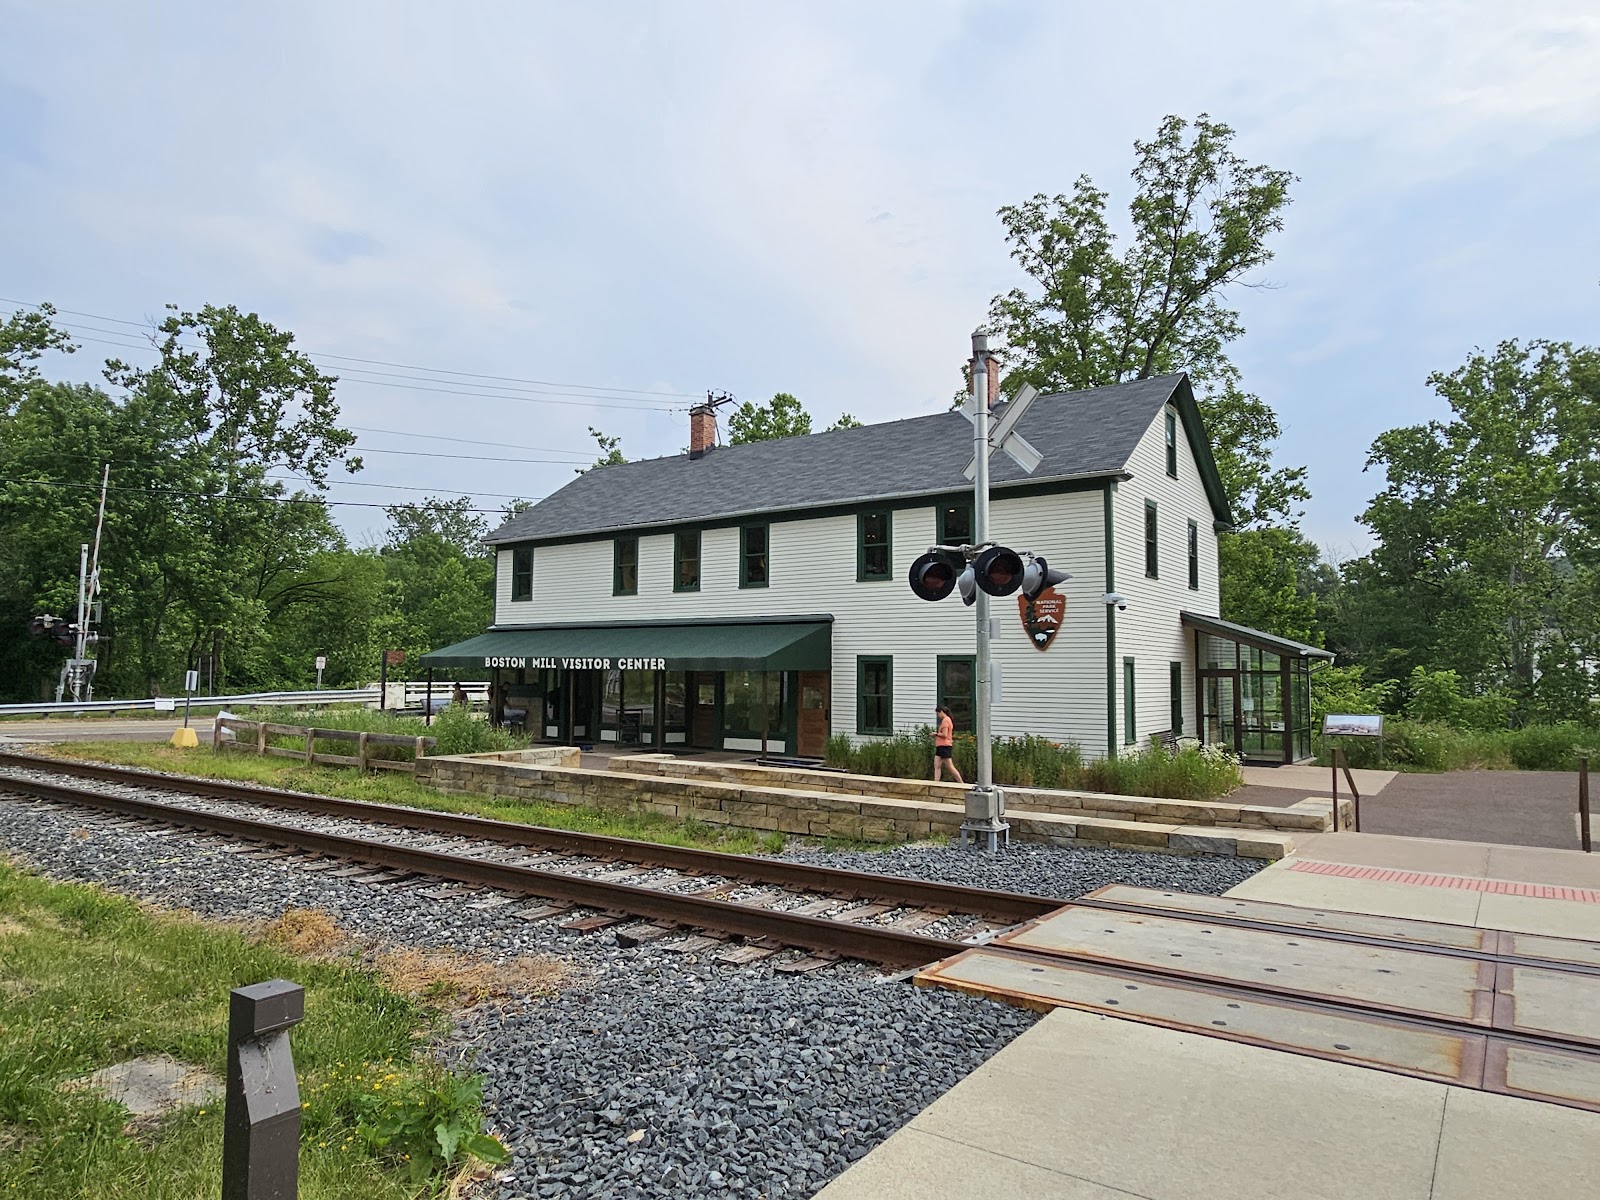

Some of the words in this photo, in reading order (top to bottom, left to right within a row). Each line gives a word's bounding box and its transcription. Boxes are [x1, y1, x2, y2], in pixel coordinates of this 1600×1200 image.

[484, 657, 526, 668] BOSTON
[532, 657, 557, 669] MILL
[561, 658, 611, 670] VISITOR
[617, 658, 666, 670] CENTER
